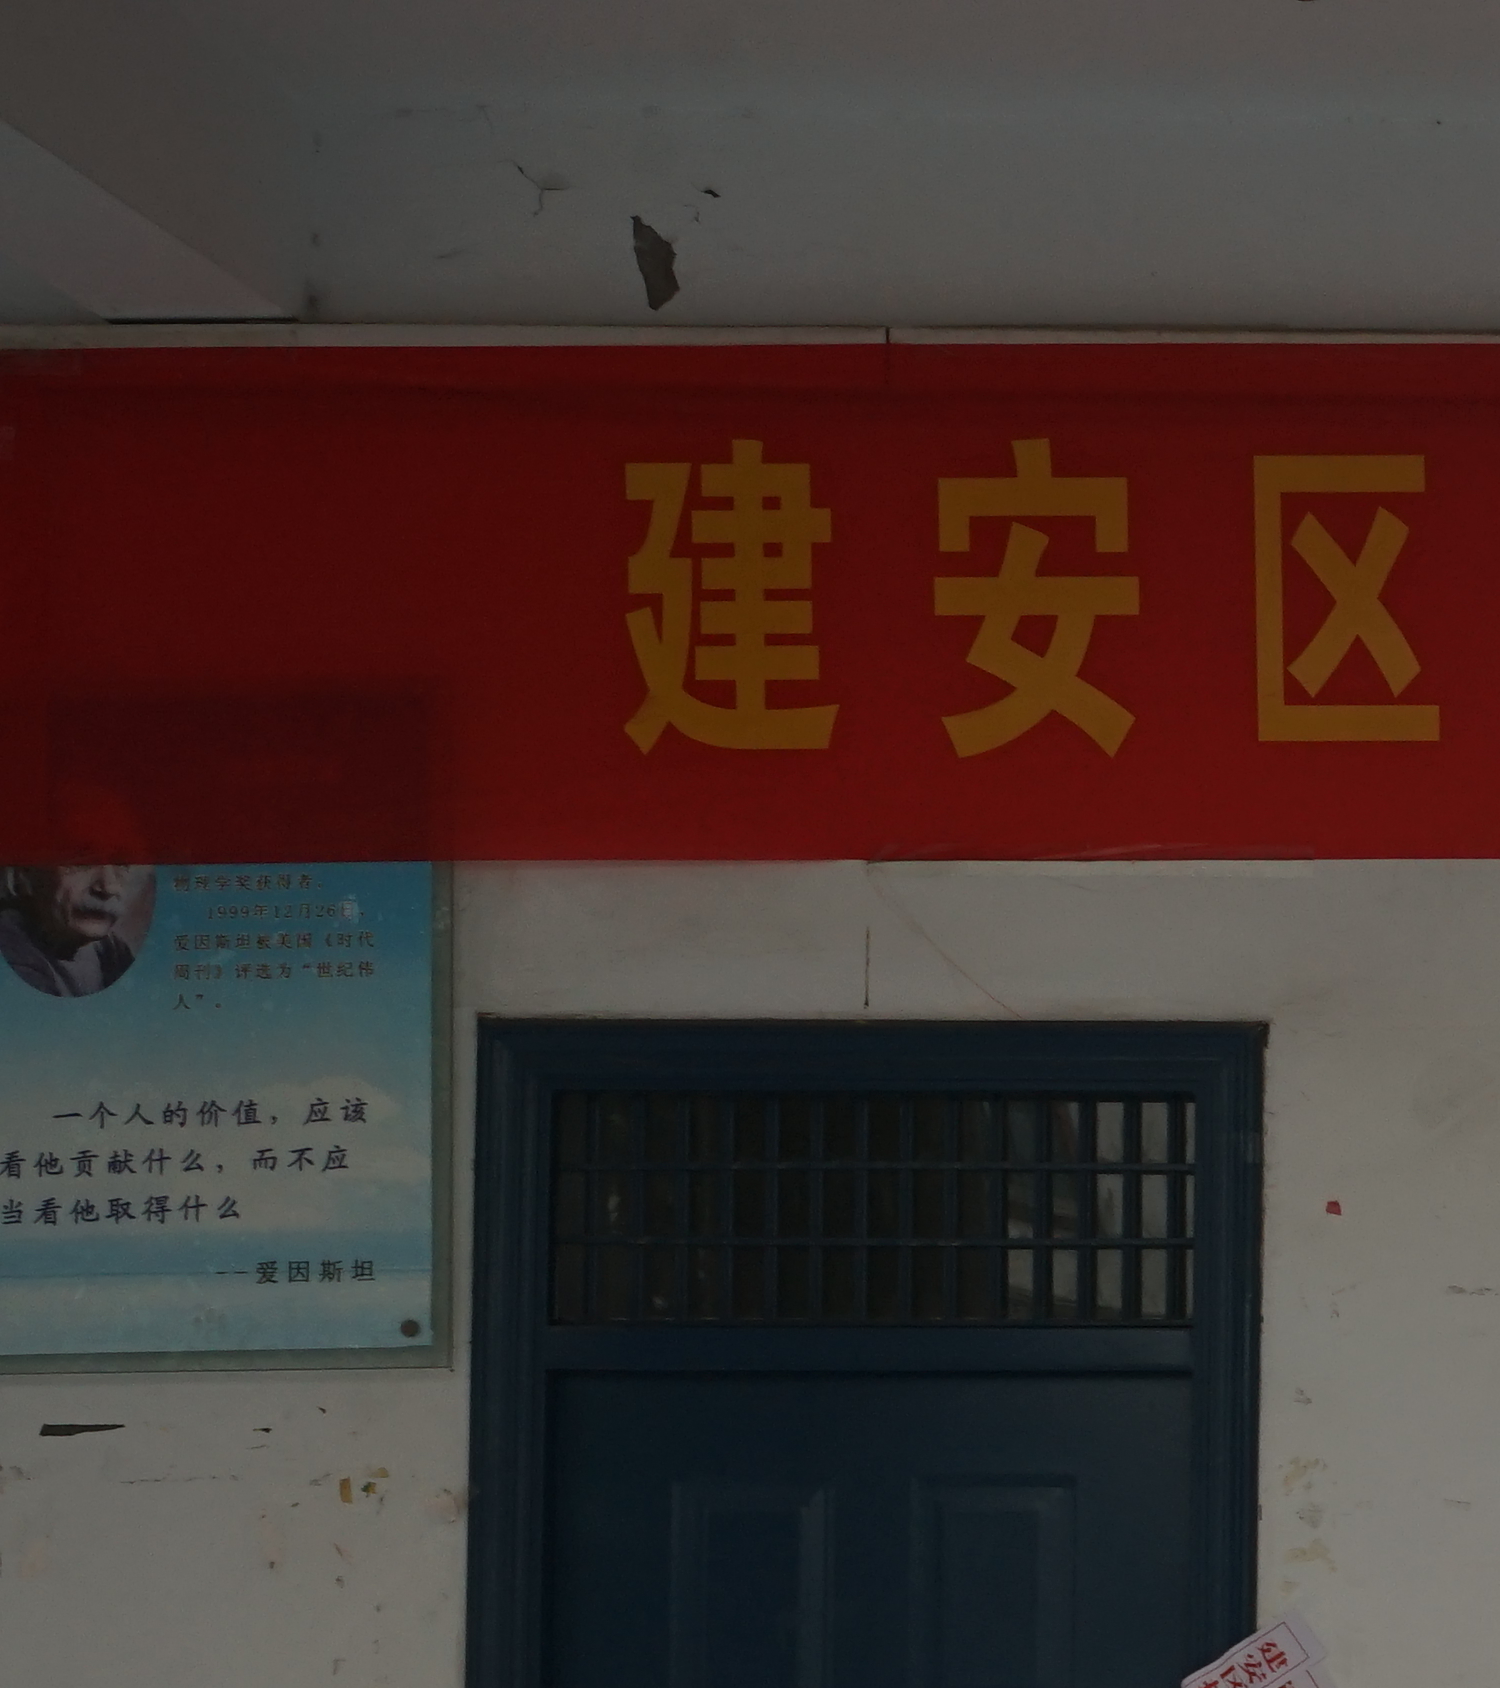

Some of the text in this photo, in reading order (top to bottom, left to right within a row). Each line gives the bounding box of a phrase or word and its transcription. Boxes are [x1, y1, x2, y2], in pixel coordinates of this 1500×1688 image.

[0, 1196, 242, 1227] 当看他取得什么
